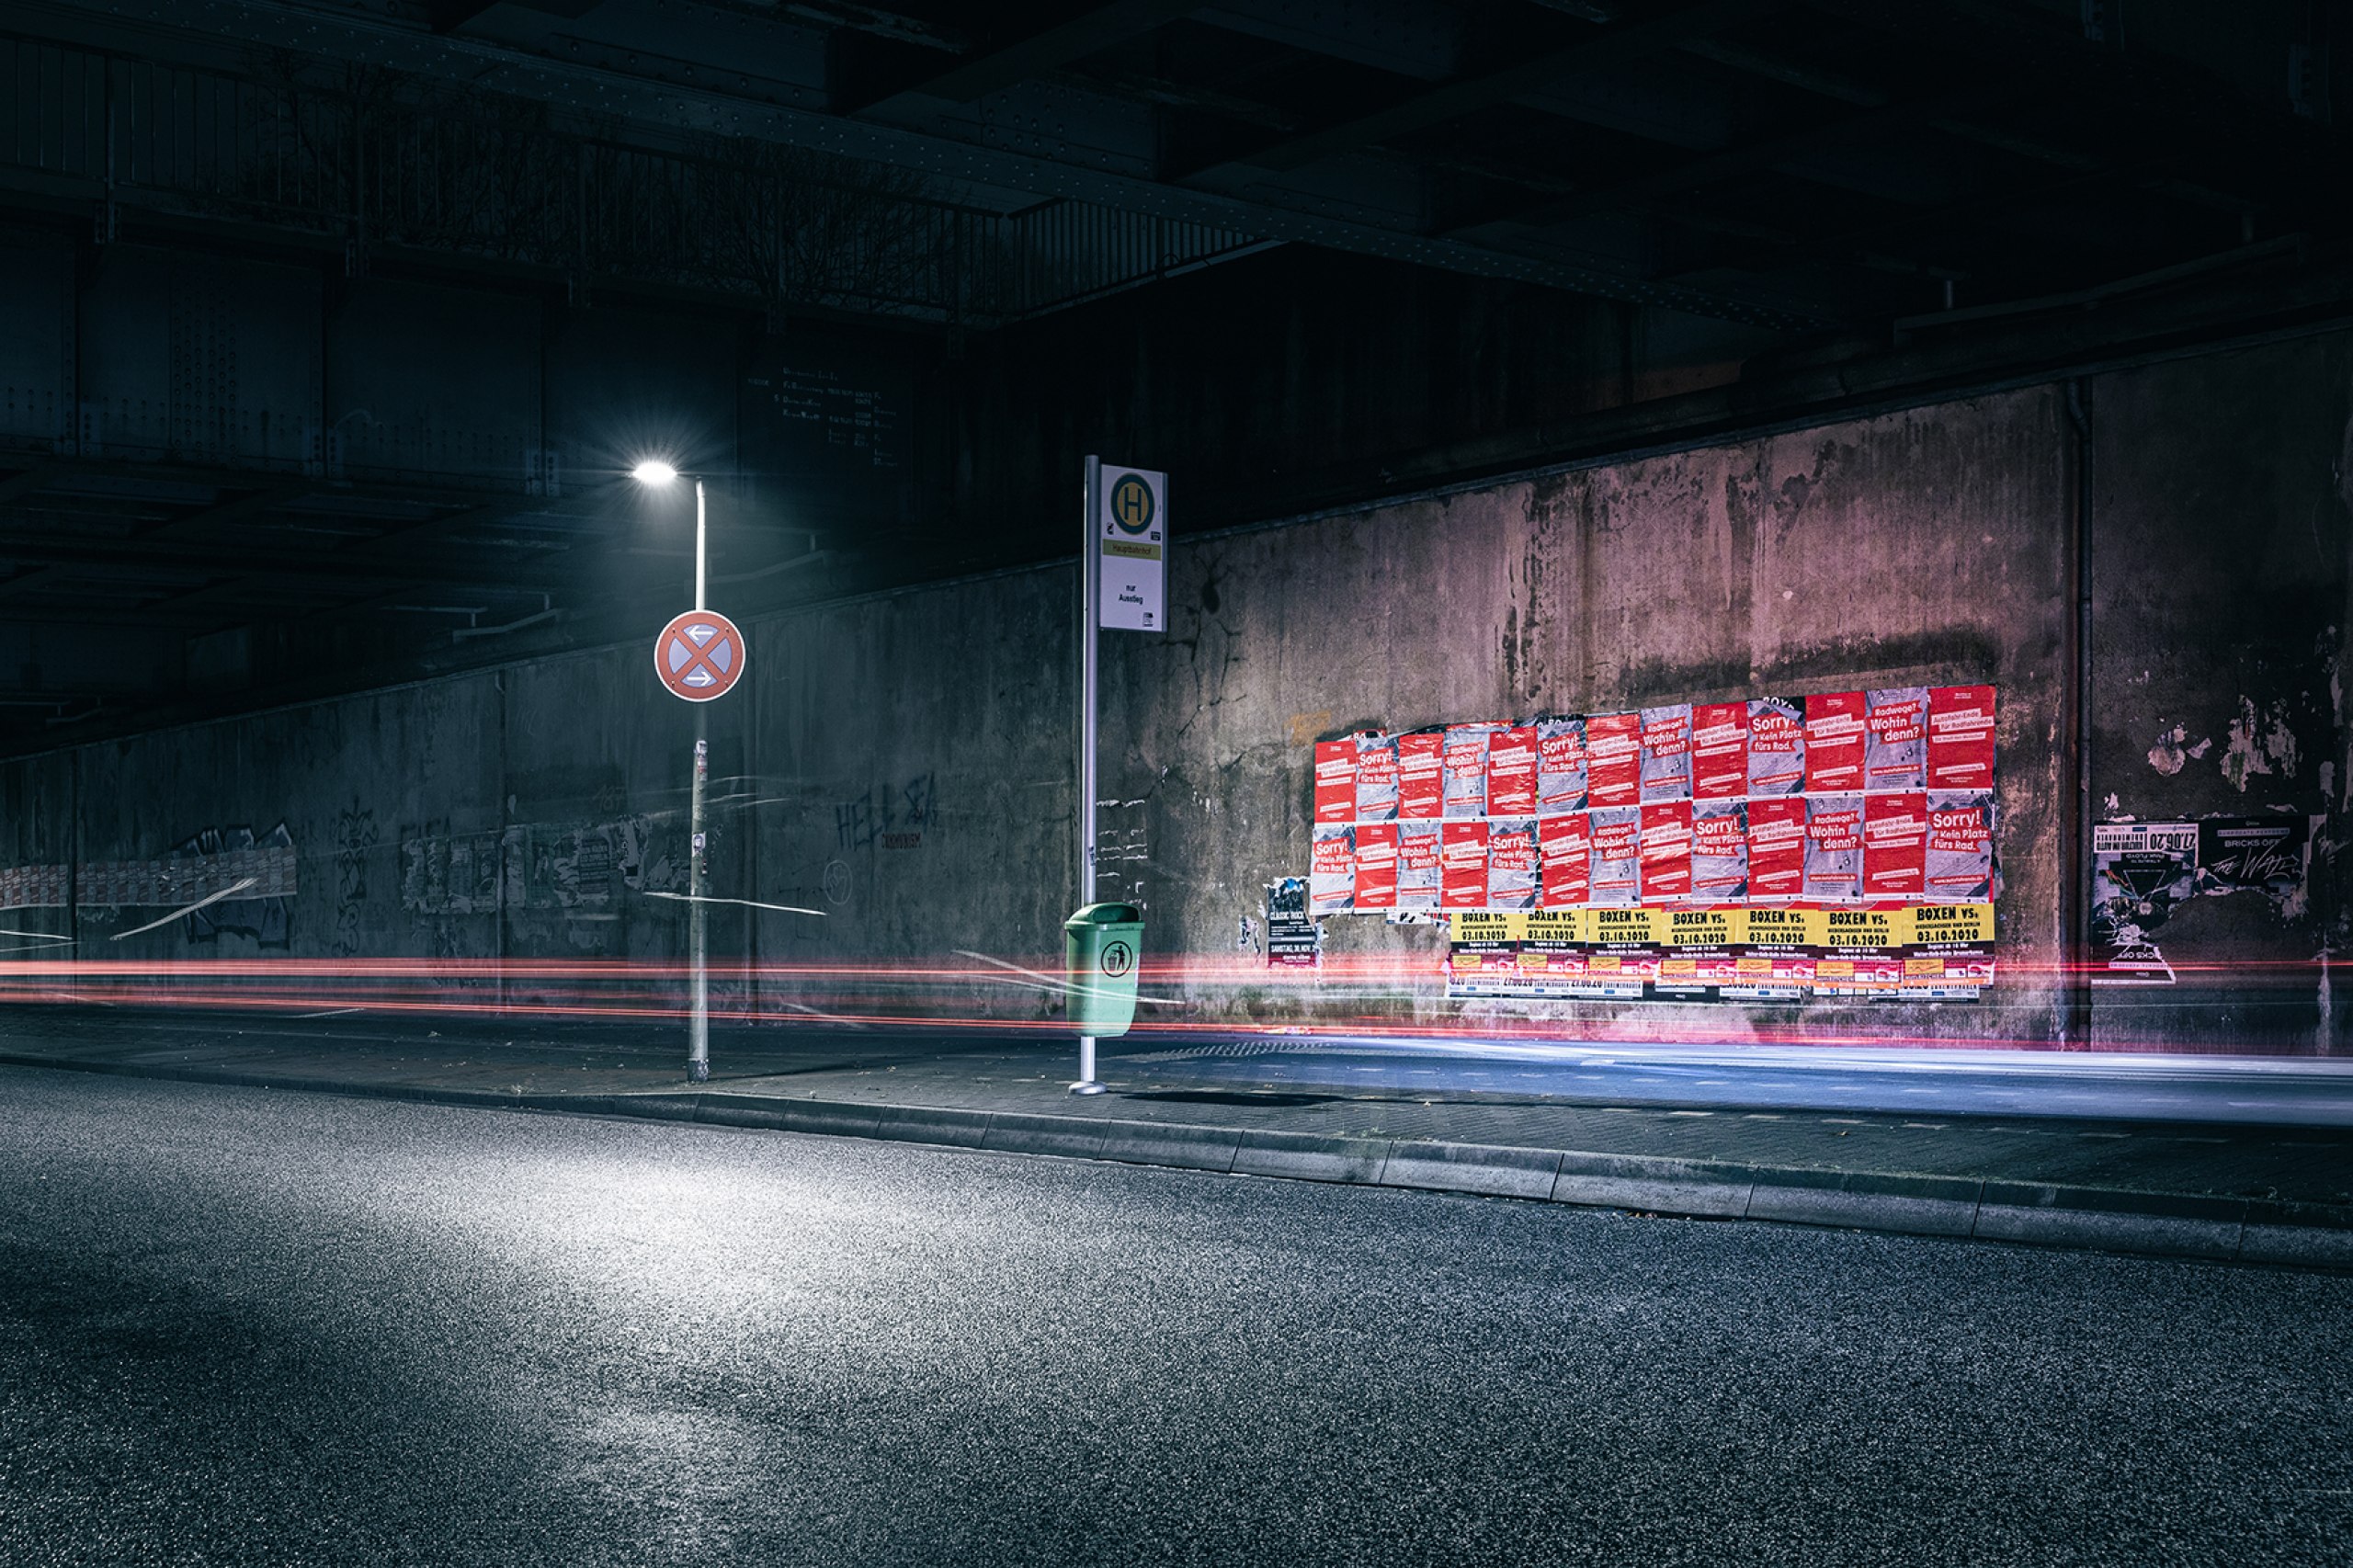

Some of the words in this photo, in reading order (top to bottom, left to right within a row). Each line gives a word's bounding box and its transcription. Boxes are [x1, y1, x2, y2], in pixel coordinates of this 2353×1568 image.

[1124, 487, 1142, 521] H
[1119, 594, 1143, 605] Ausstieg
[1870, 716, 1907, 730] Wohin
[1884, 726, 1920, 742] denn?
[1814, 812, 1855, 824] Radwege?
[1933, 810, 1980, 827] Sorry!
[1697, 816, 1738, 835] Sorry!
[1810, 824, 1846, 837] Wohin
[1962, 829, 1988, 838] Platz
[1824, 836, 1858, 849] denn?
[1934, 839, 1952, 848] fürs
[2151, 833, 2196, 849] 27.06.20
[2224, 839, 2260, 847] BRICKS
[1599, 911, 1631, 923] BOXEN
[1673, 913, 1708, 926] BOXEN
[1749, 911, 1785, 923] BOXEN
[1829, 913, 1867, 925] BOXEN
[1916, 907, 1956, 920] BOXEN
[1599, 930, 1649, 941] 03.10.2020
[1673, 933, 1725, 944] 03.10.2020
[1749, 932, 1804, 943] 03.10.2020
[1829, 935, 1887, 946] 03.10.2020
[1917, 929, 1978, 941] 03.10.2020
